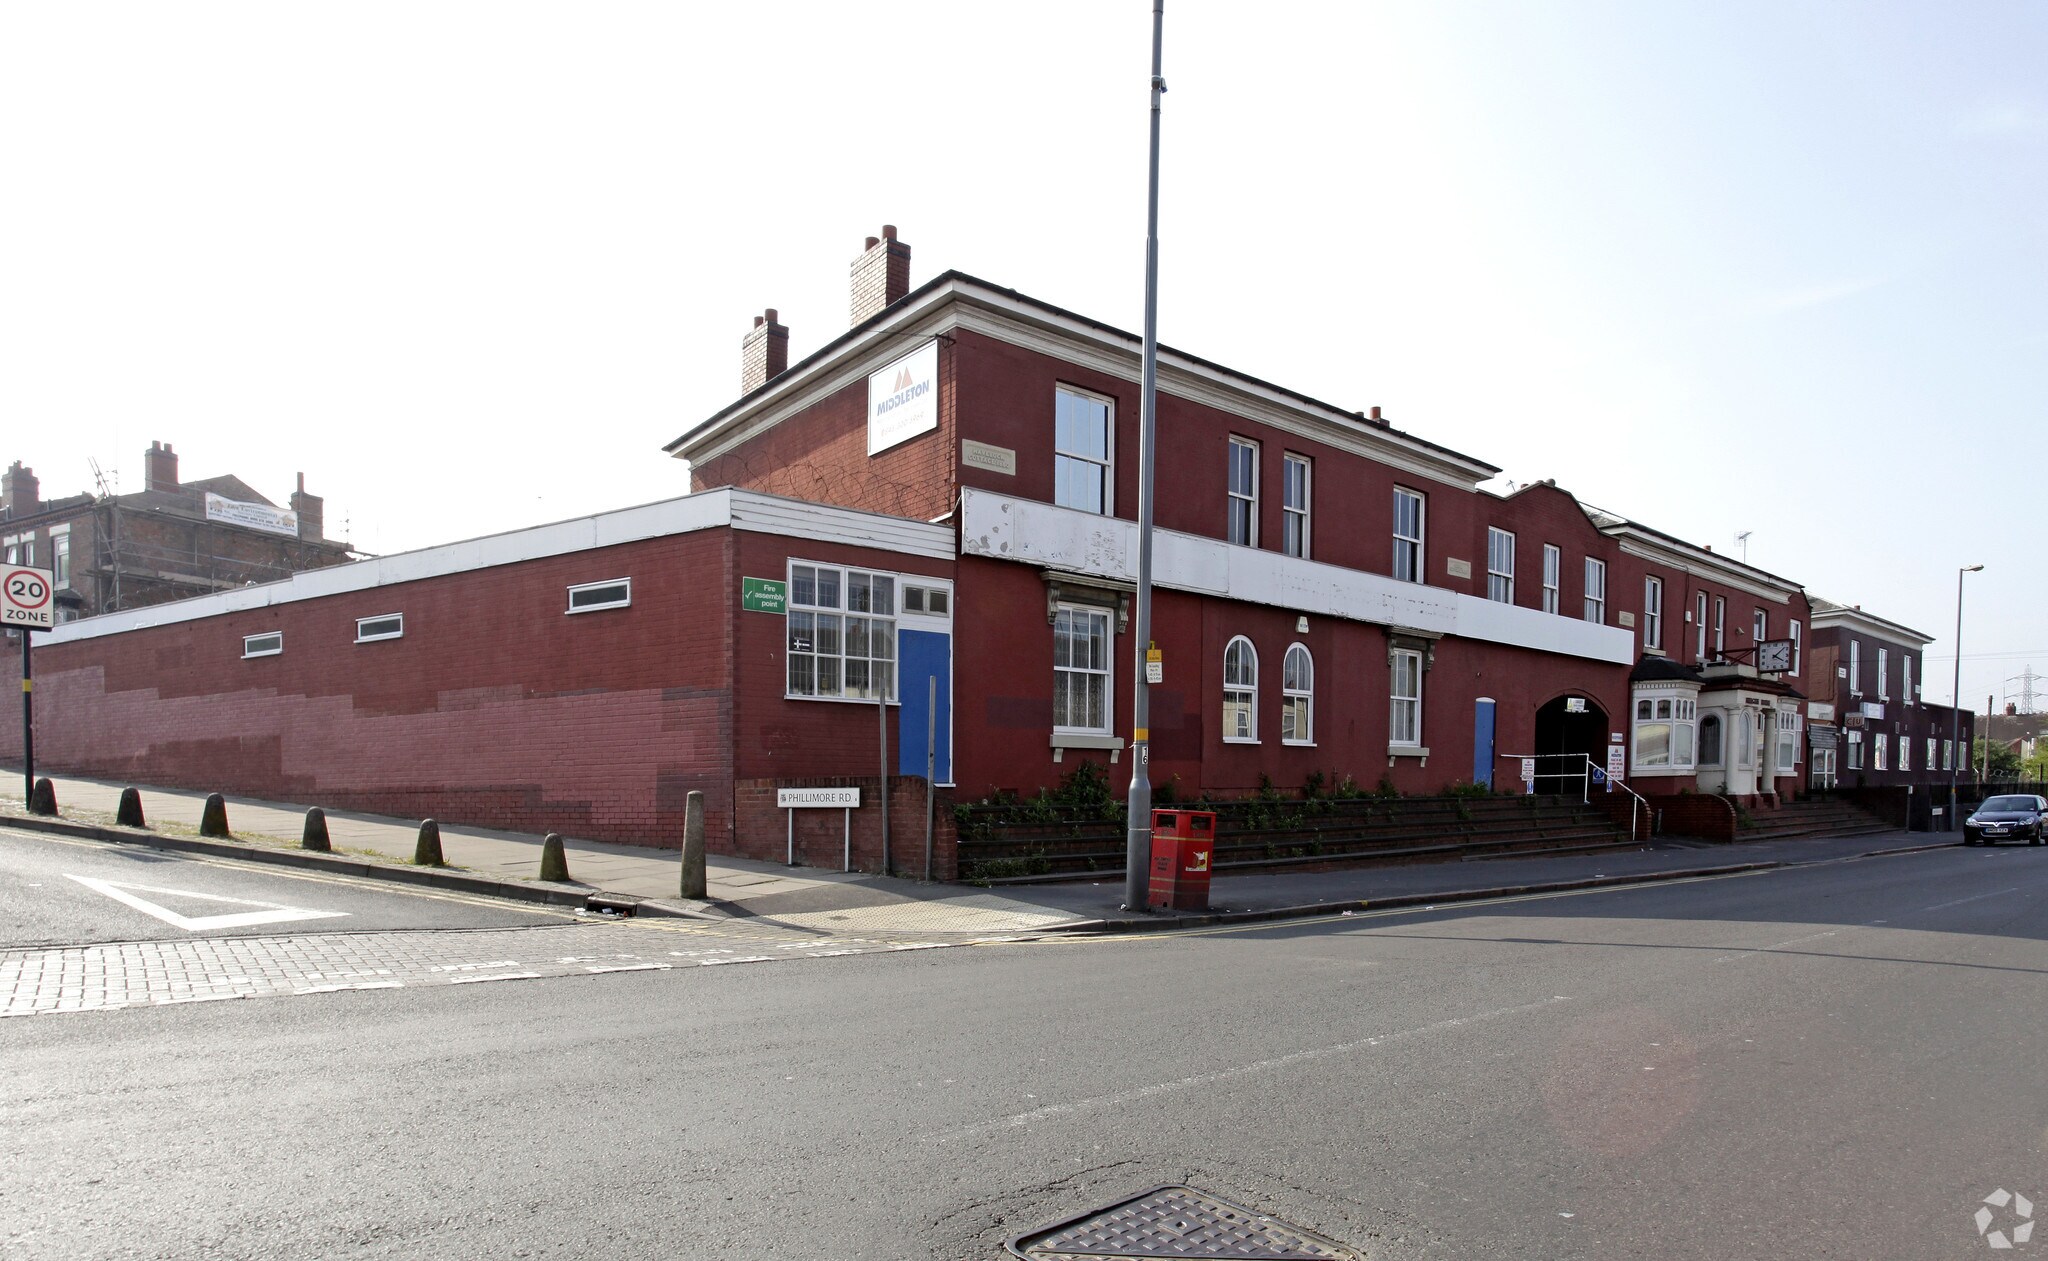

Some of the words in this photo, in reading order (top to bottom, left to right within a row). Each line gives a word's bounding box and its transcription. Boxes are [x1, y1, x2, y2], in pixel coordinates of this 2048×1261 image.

[877, 379, 930, 416] MIDDLETON
[12, 580, 43, 598] 20
[763, 584, 776, 592] Fire
[754, 592, 785, 602] assembly
[6, 609, 49, 623] ZONE
[788, 793, 836, 802] PHILLIMORE
